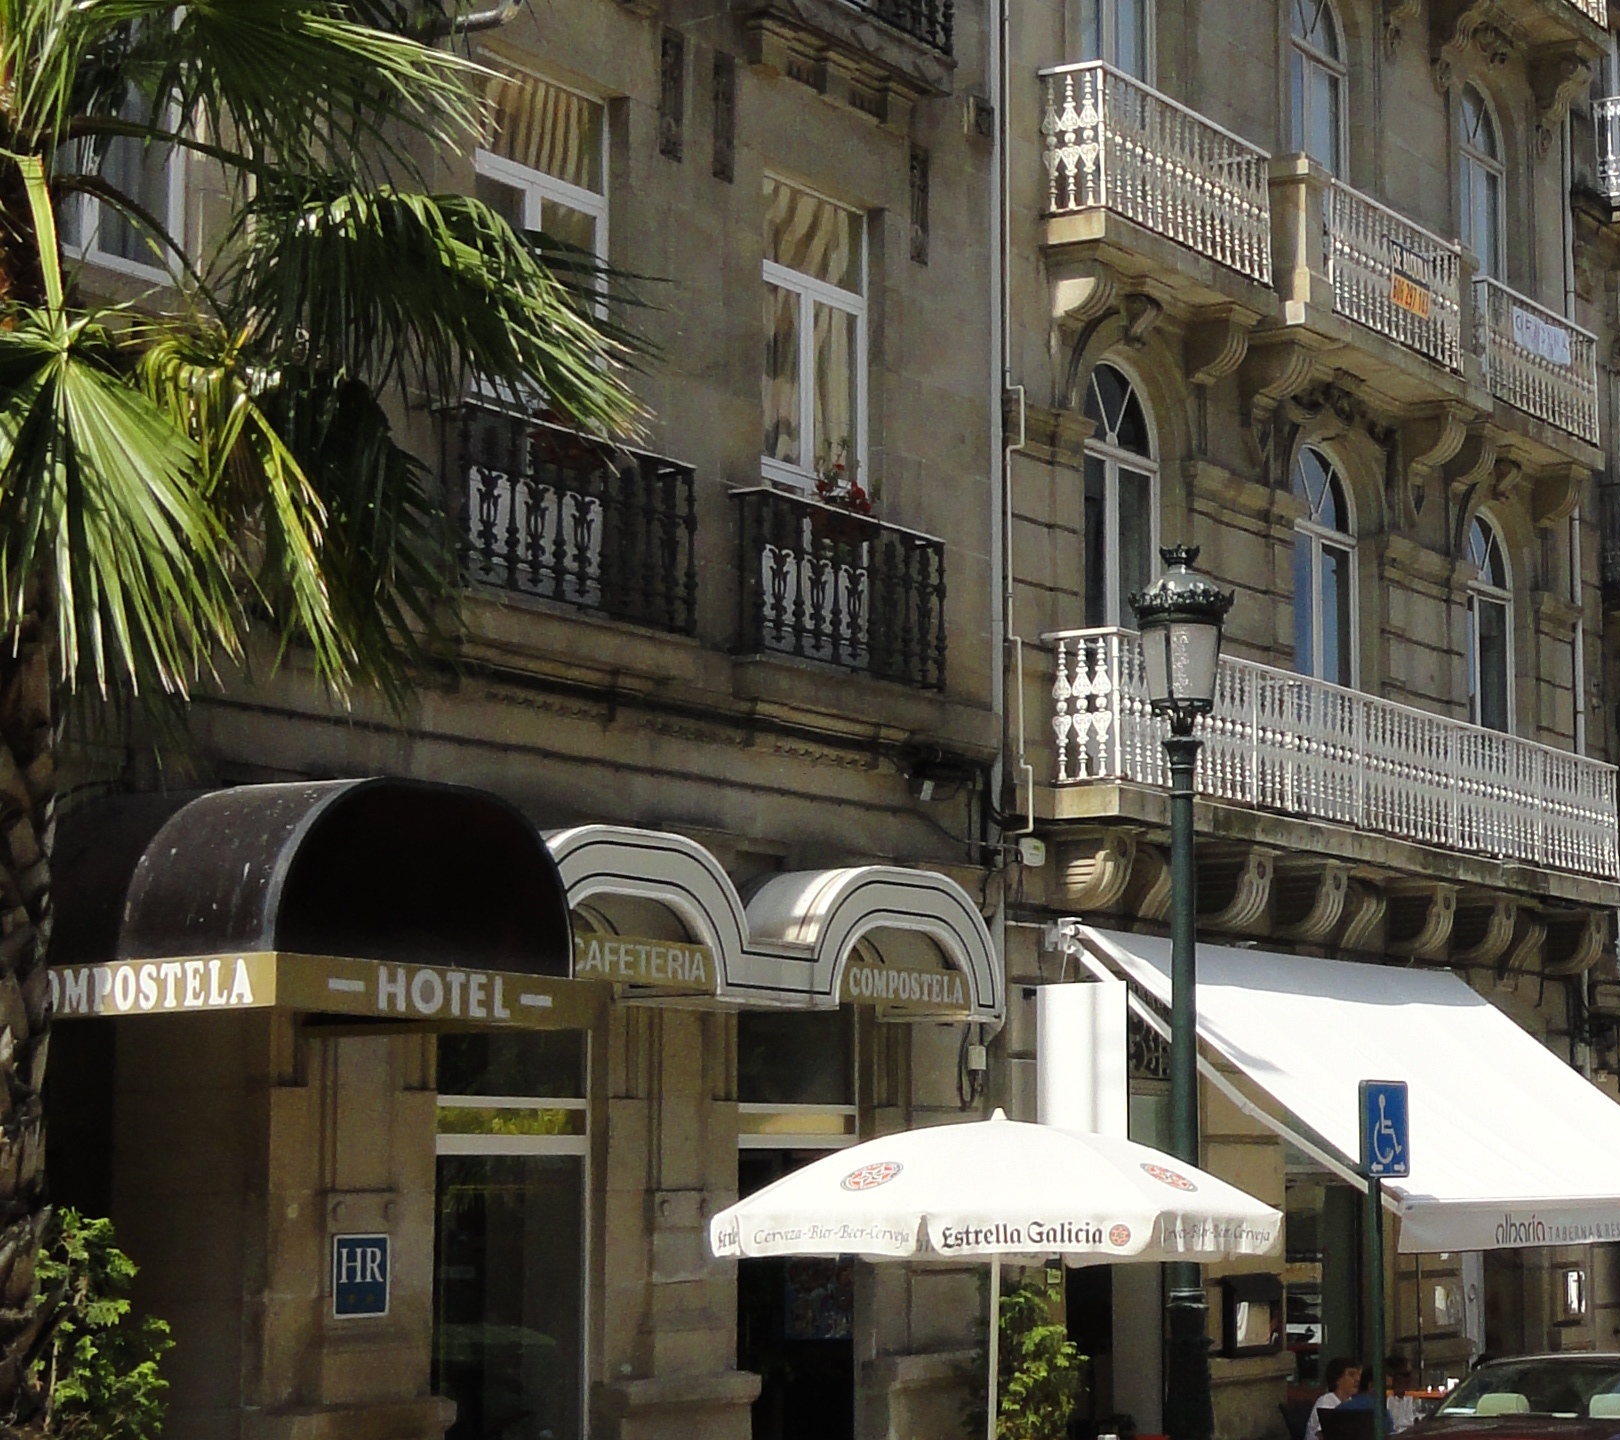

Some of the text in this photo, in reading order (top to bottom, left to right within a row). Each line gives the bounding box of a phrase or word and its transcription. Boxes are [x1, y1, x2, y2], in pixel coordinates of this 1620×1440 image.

[574, 936, 707, 984] CAFETERIA
[48, 958, 255, 1014] OMPOSTELA
[378, 966, 511, 1020] HOTEL
[849, 967, 964, 1006] COMPOSTELA
[941, 1222, 1023, 1249] Estrella
[1027, 1220, 1103, 1245] Galicia
[1548, 1225, 1594, 1242] TABERNA
[340, 1246, 384, 1284] HR
